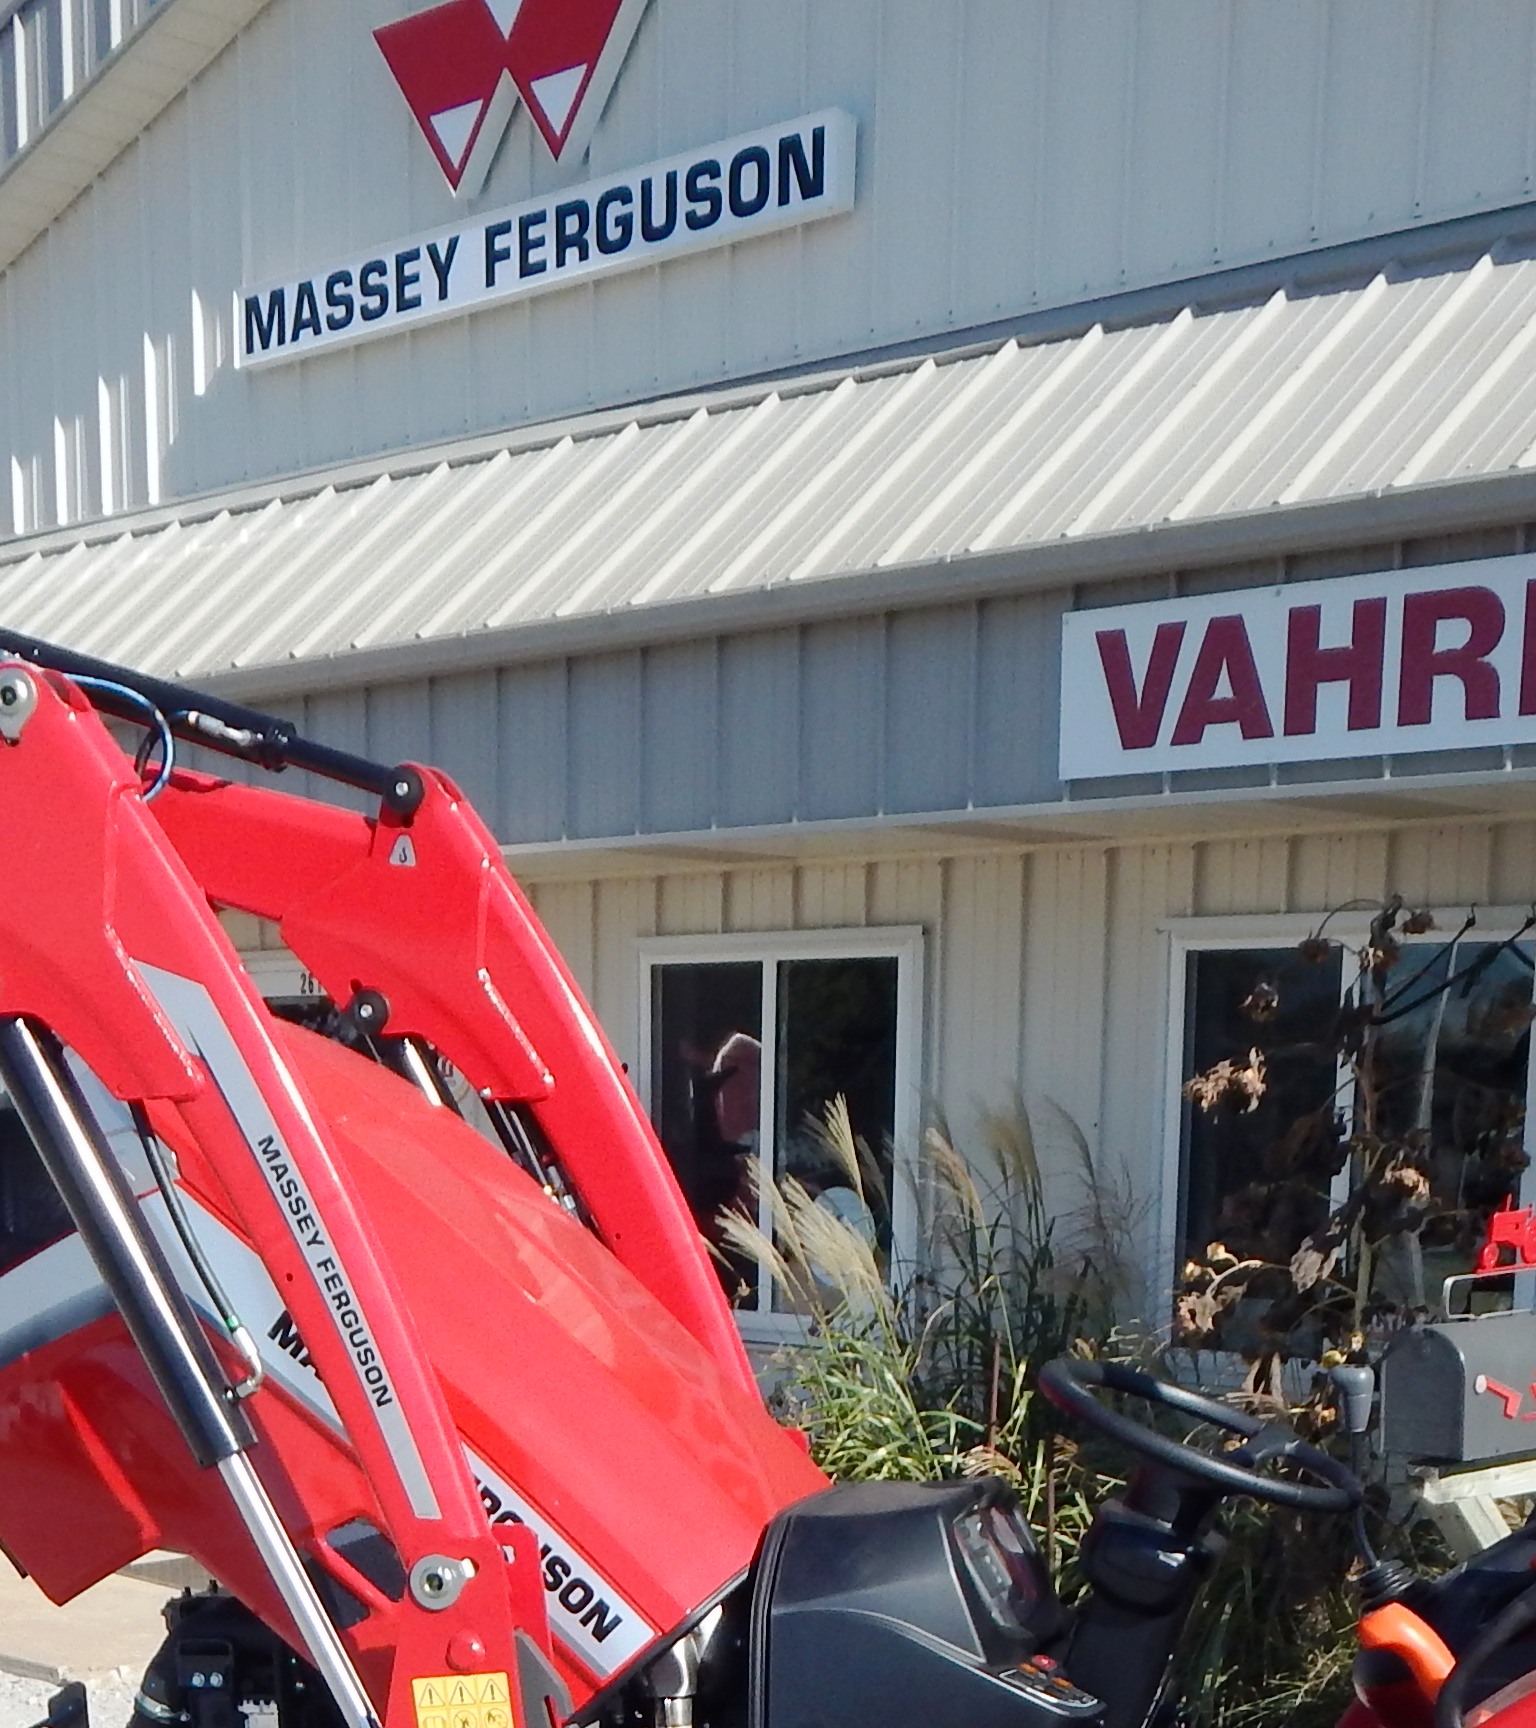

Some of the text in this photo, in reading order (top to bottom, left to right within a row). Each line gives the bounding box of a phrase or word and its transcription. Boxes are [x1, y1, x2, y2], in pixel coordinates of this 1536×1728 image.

[244, 126, 827, 356] MASSEY FERGUSON
[257, 1134, 326, 1248] MASSEY
[316, 1256, 394, 1408] FERGUSON
